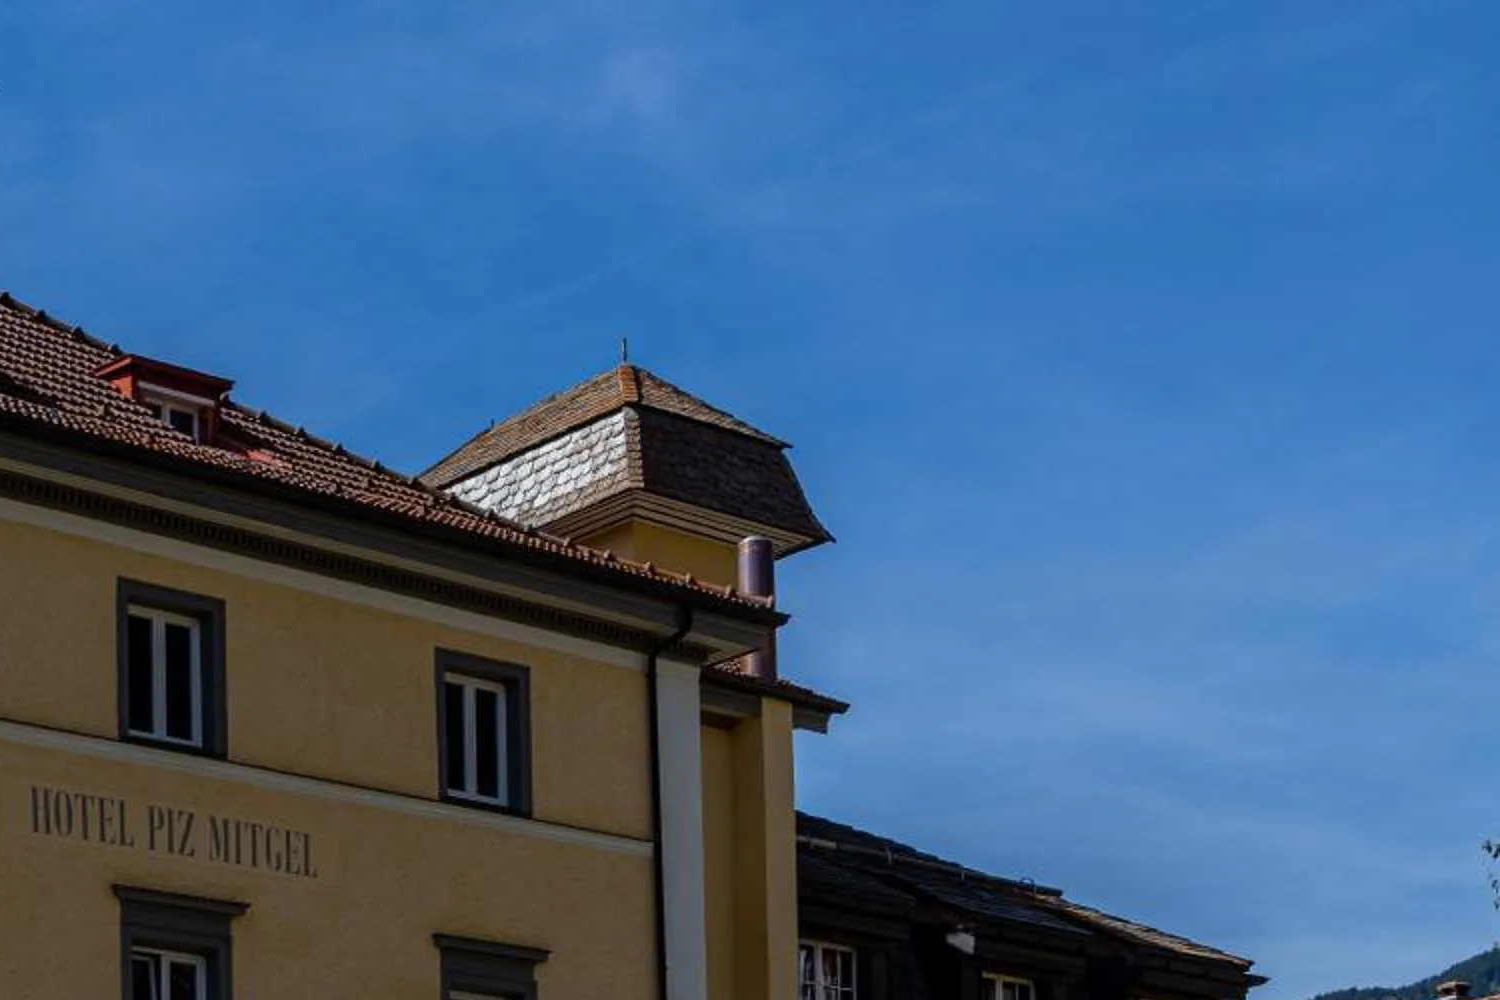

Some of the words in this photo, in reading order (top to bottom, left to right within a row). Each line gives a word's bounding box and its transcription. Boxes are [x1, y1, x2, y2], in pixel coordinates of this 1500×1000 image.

[31, 785, 135, 848] HOTEL
[147, 804, 196, 857] PIZ
[209, 815, 318, 878] MITGEL
